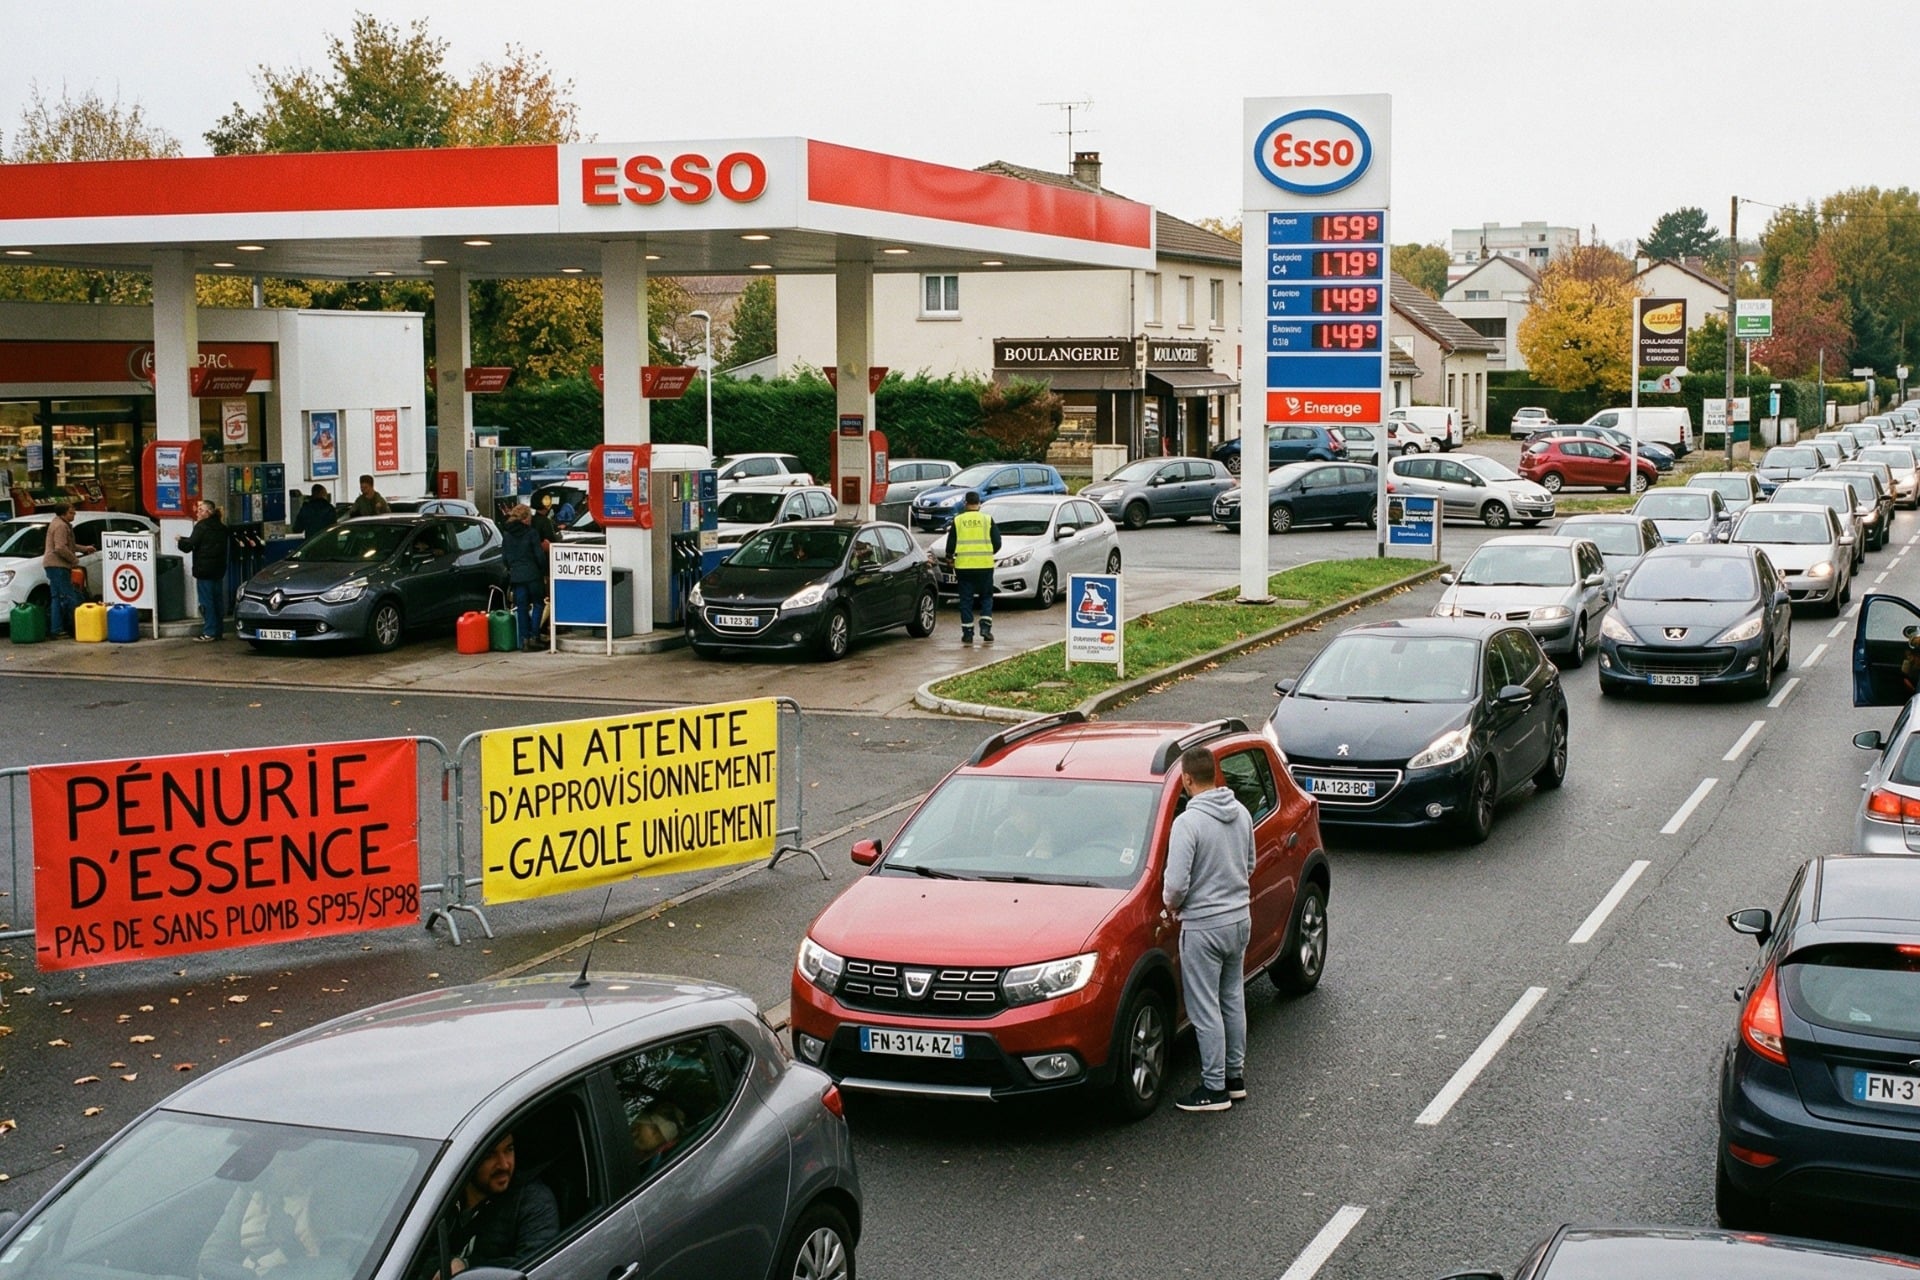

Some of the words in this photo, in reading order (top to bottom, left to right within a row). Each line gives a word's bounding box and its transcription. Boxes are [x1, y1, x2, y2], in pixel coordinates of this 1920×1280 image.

[1273, 133, 1354, 167] Esso
[581, 152, 767, 205] ESSO
[1004, 347, 1120, 361] BOULANGERIE
[106, 539, 149, 550] LIMITATION
[108, 551, 148, 561] 30L/PERS
[555, 551, 605, 563] LIMITATION
[118, 575, 138, 592] 30
[557, 564, 602, 576] 30L/PERS
[513, 733, 564, 775] EN
[583, 710, 748, 767] ATTENTE
[66, 749, 369, 841] PÉNURIE
[489, 750, 776, 824] D'APPROVISIONNEMENT
[643, 800, 776, 858] UNIQUEMENT
[69, 822, 391, 910] D'ESSENCE
[114, 918, 144, 952] DE
[153, 909, 219, 945] SANS
[226, 899, 299, 937] PLOMB
[306, 883, 419, 926] SP95/SP98
